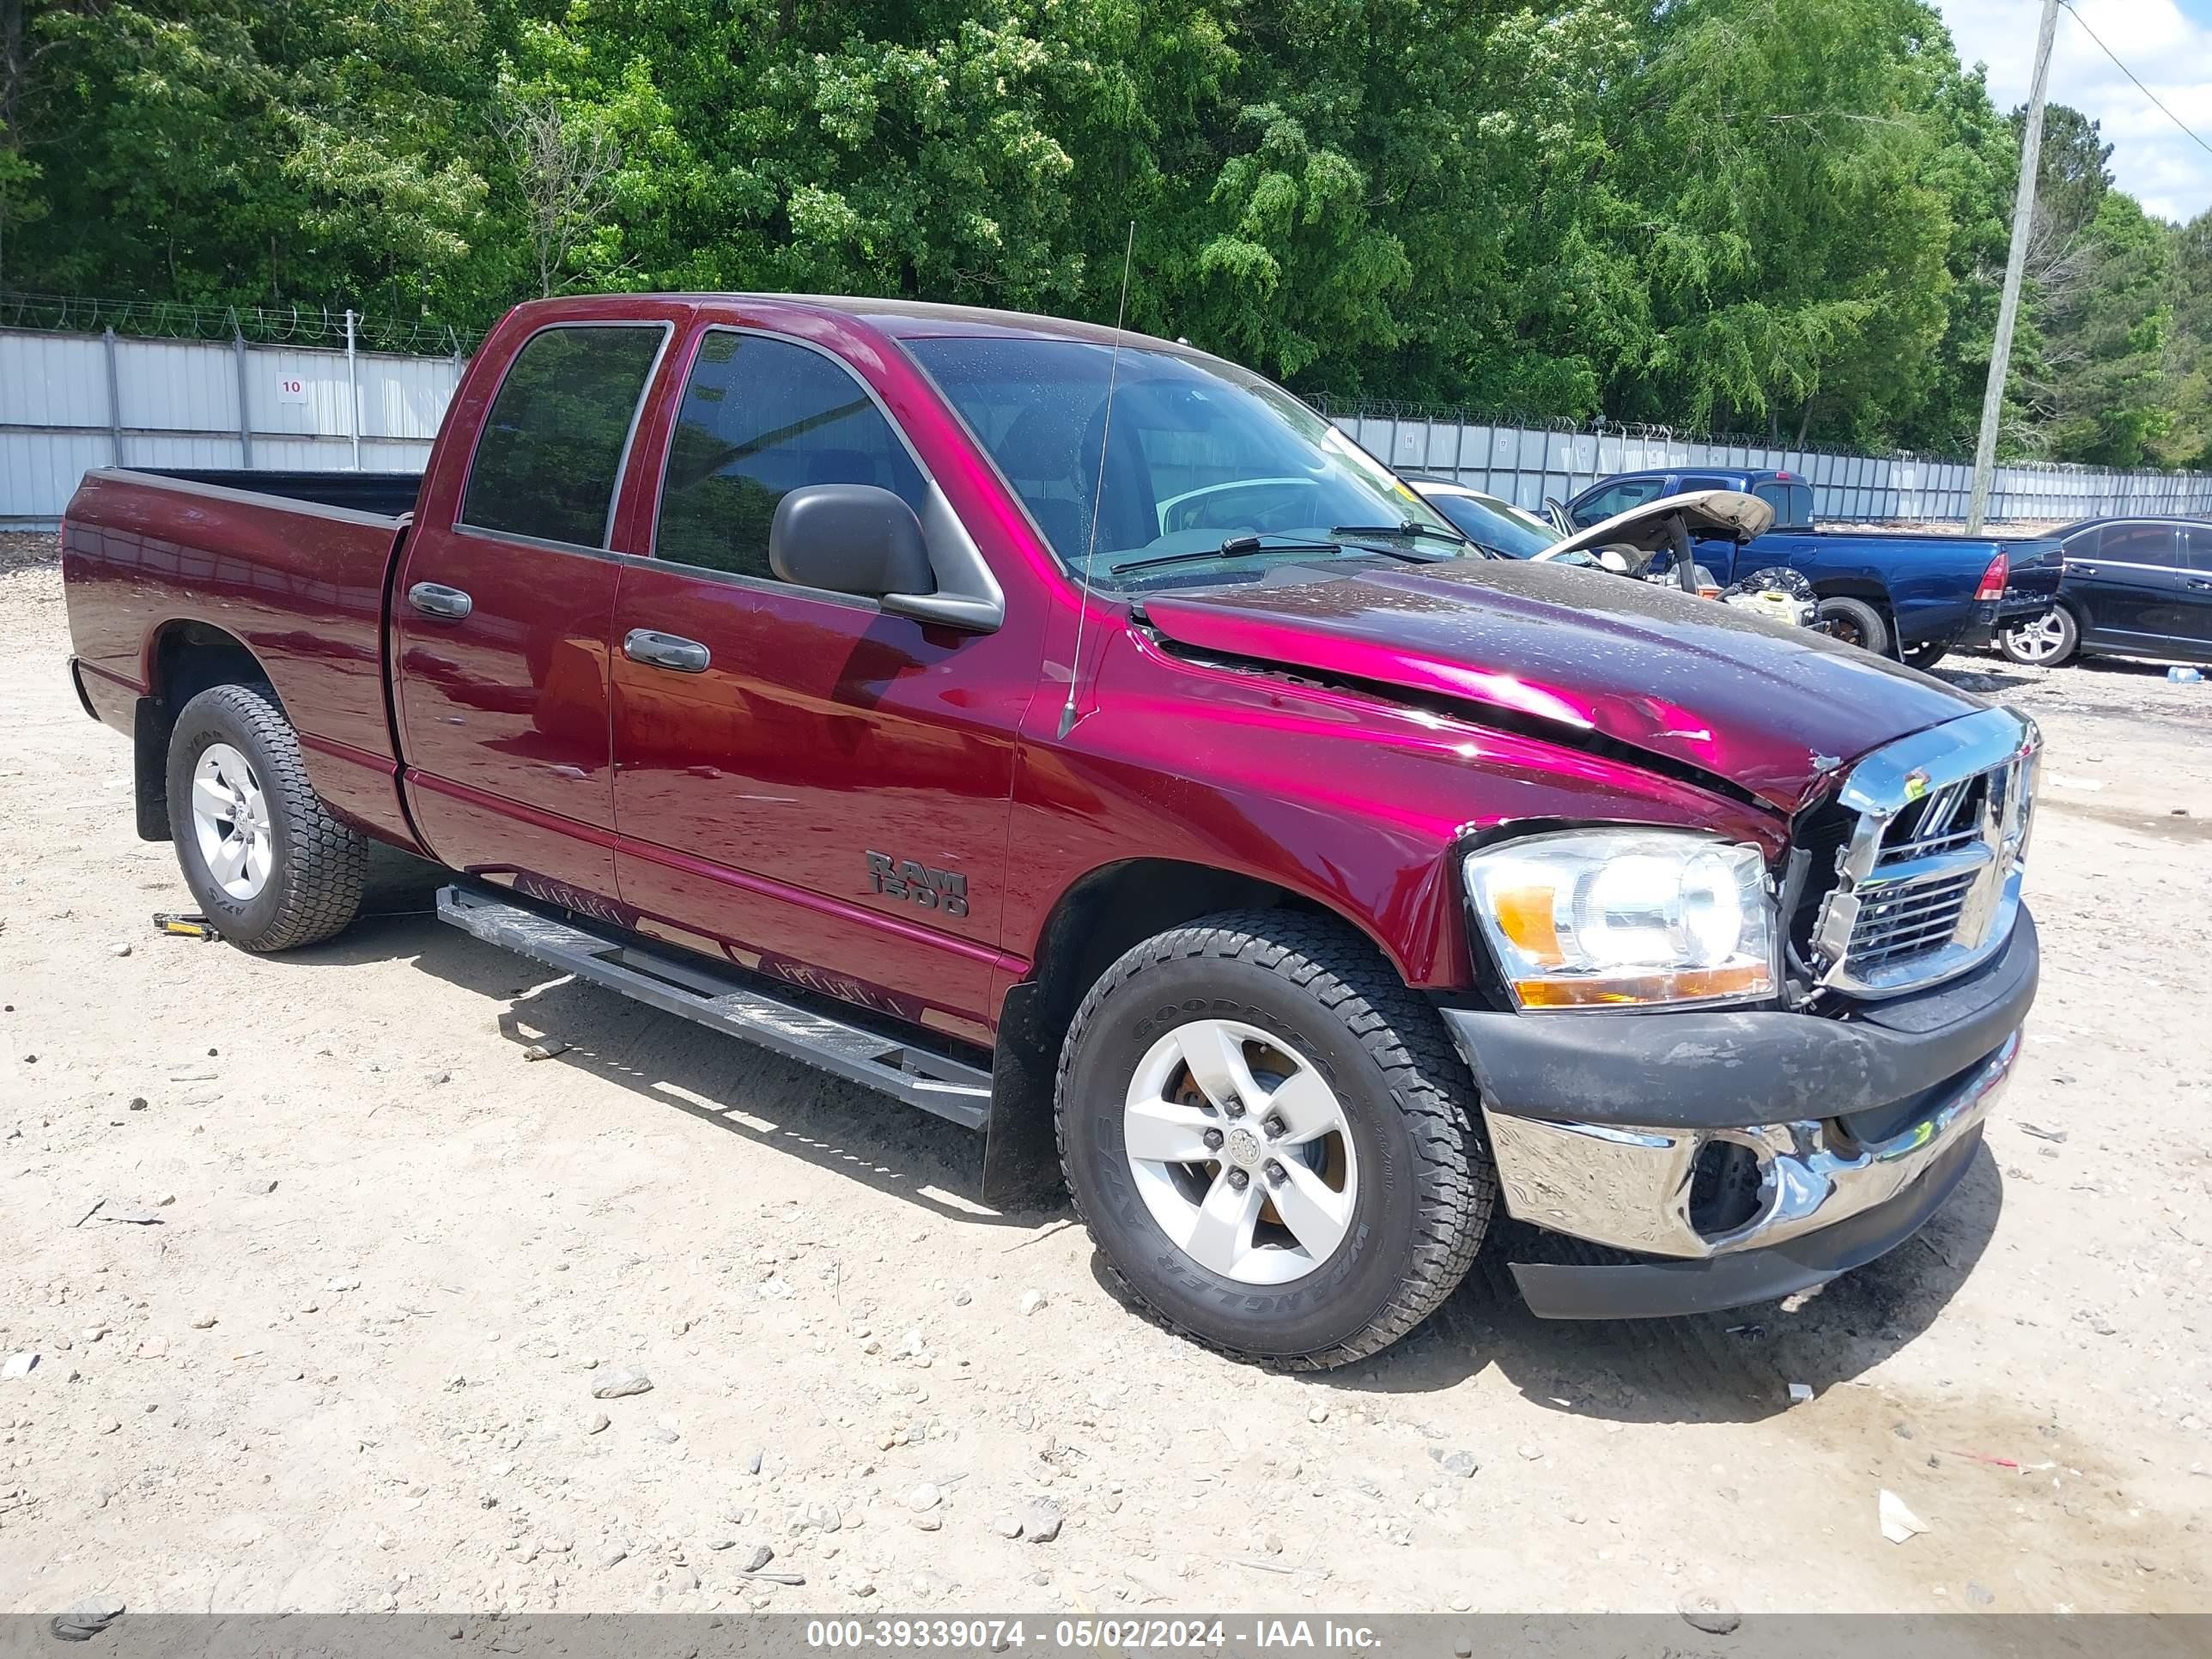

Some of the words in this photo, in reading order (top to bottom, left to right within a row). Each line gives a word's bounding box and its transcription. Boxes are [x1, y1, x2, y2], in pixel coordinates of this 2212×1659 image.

[283, 381, 301, 392] 10
[866, 848, 968, 896] RAM
[868, 872, 969, 917] 1500
[1133, 997, 1362, 1124] GOODYEAR
[1156, 1222, 1371, 1313] WRANGLER
